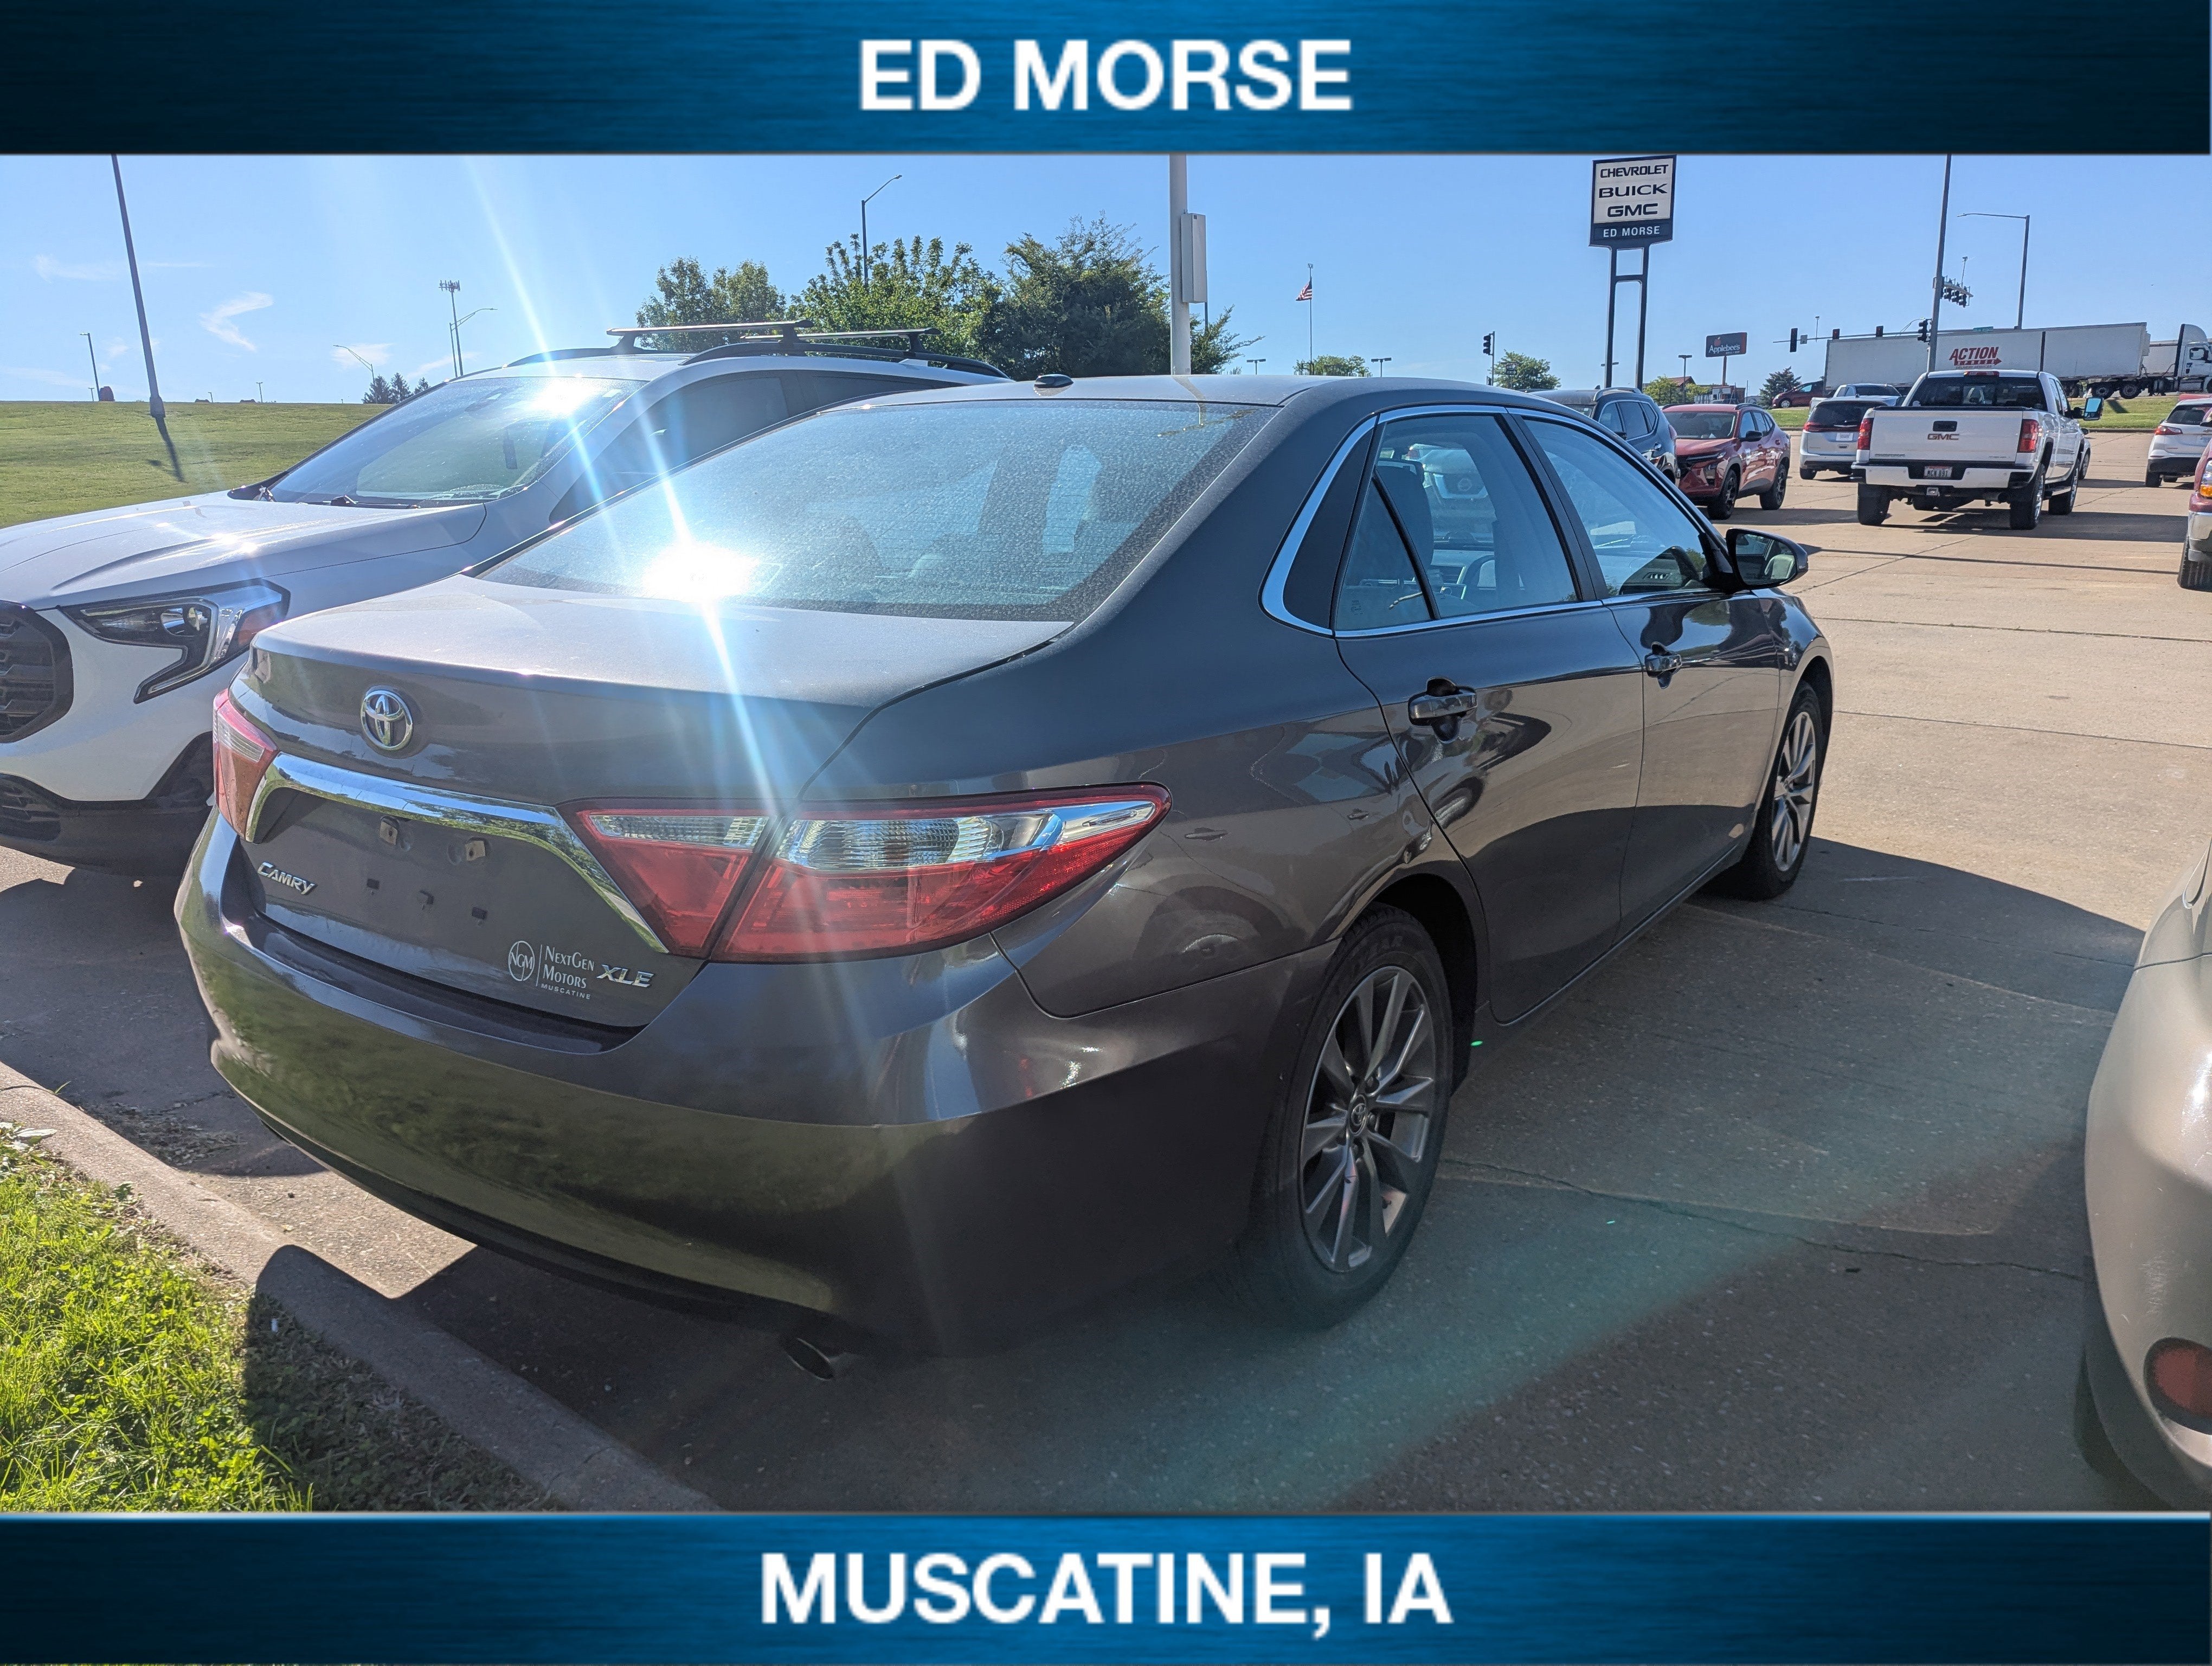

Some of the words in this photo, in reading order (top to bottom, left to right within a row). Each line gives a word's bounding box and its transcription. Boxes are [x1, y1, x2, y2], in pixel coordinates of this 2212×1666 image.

[1600, 164, 1669, 178] CHEVROLET
[1598, 183, 1668, 198] BUICK
[1607, 203, 1658, 217] GMC
[1603, 228, 1617, 238] ED
[1622, 226, 1661, 237] MORSE
[1708, 344, 1740, 354] Applebee's
[1949, 347, 1999, 361] ACTION
[258, 862, 316, 895] CAMRY
[545, 945, 595, 971] NEXTGEN
[543, 964, 587, 989] MOTORS
[596, 964, 654, 988] XLE
[541, 983, 591, 999] MUSCATINE
